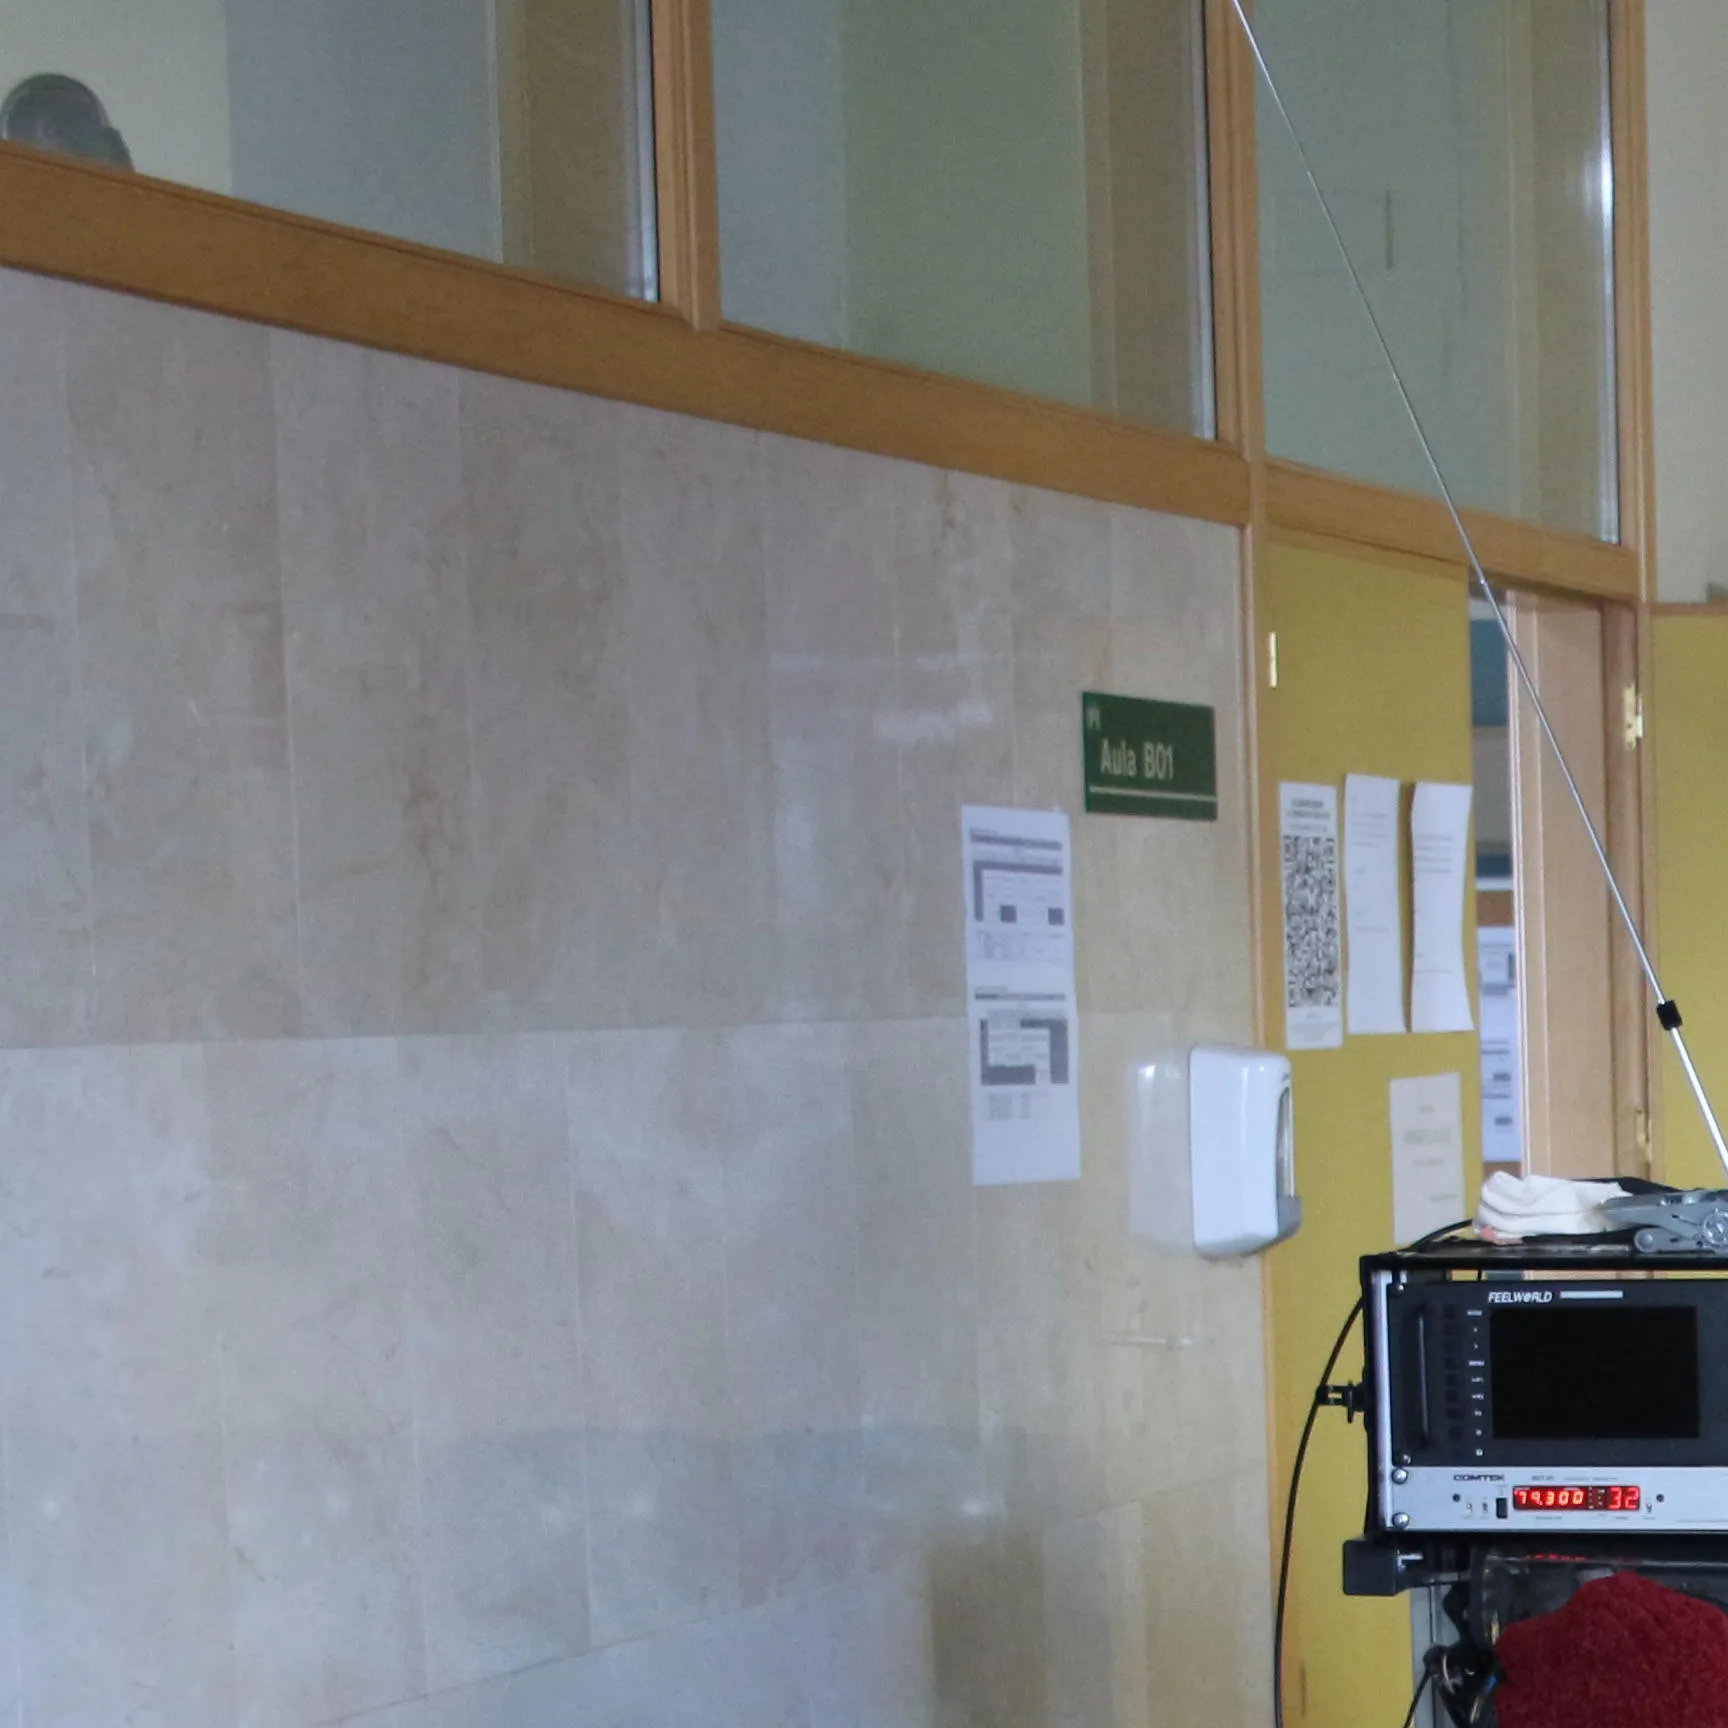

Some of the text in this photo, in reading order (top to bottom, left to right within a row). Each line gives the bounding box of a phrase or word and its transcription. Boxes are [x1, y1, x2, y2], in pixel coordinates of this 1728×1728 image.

[1101, 738, 1174, 781] Aula B01
[1453, 1473, 1506, 1482] COMTEK
[1608, 1486, 1640, 1511] 32
